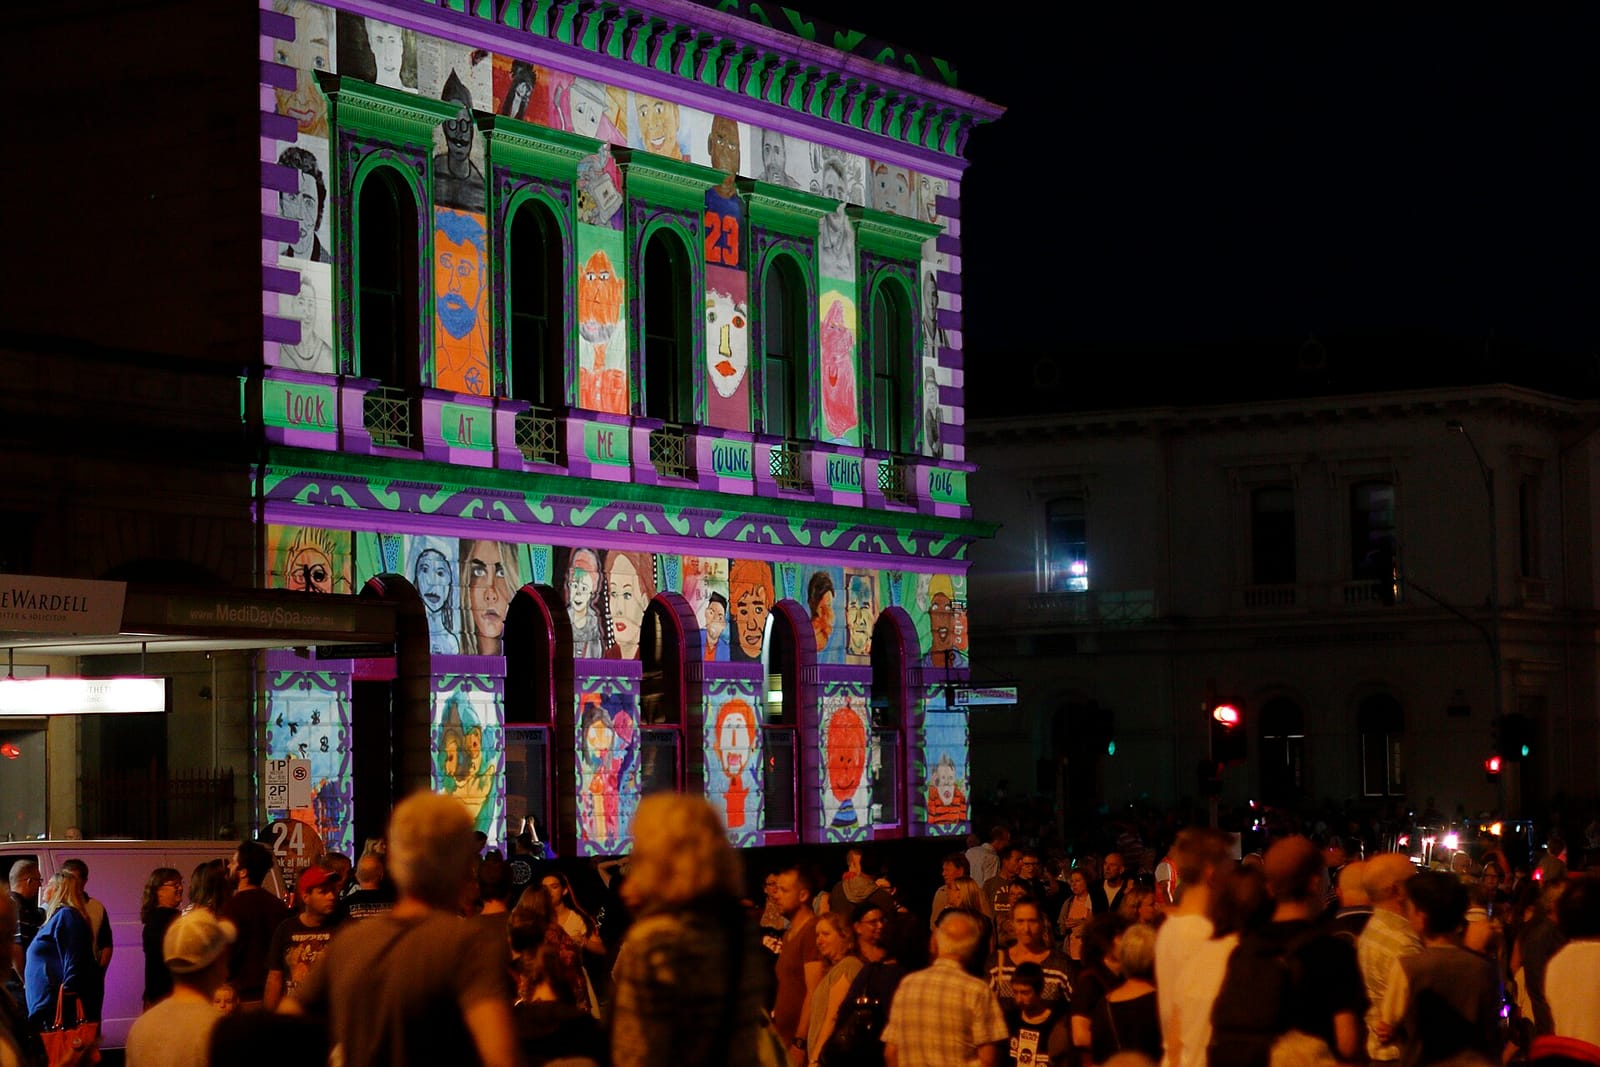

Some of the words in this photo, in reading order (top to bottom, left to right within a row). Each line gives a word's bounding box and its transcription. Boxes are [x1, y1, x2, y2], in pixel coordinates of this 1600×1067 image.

[704, 210, 739, 267] 23
[285, 389, 326, 428] LOOK
[457, 413, 474, 446] AT
[596, 428, 614, 459] ME
[929, 467, 953, 496] 2016
[269, 760, 287, 771] 1P
[269, 785, 287, 796] 2P
[271, 822, 305, 857] 24
